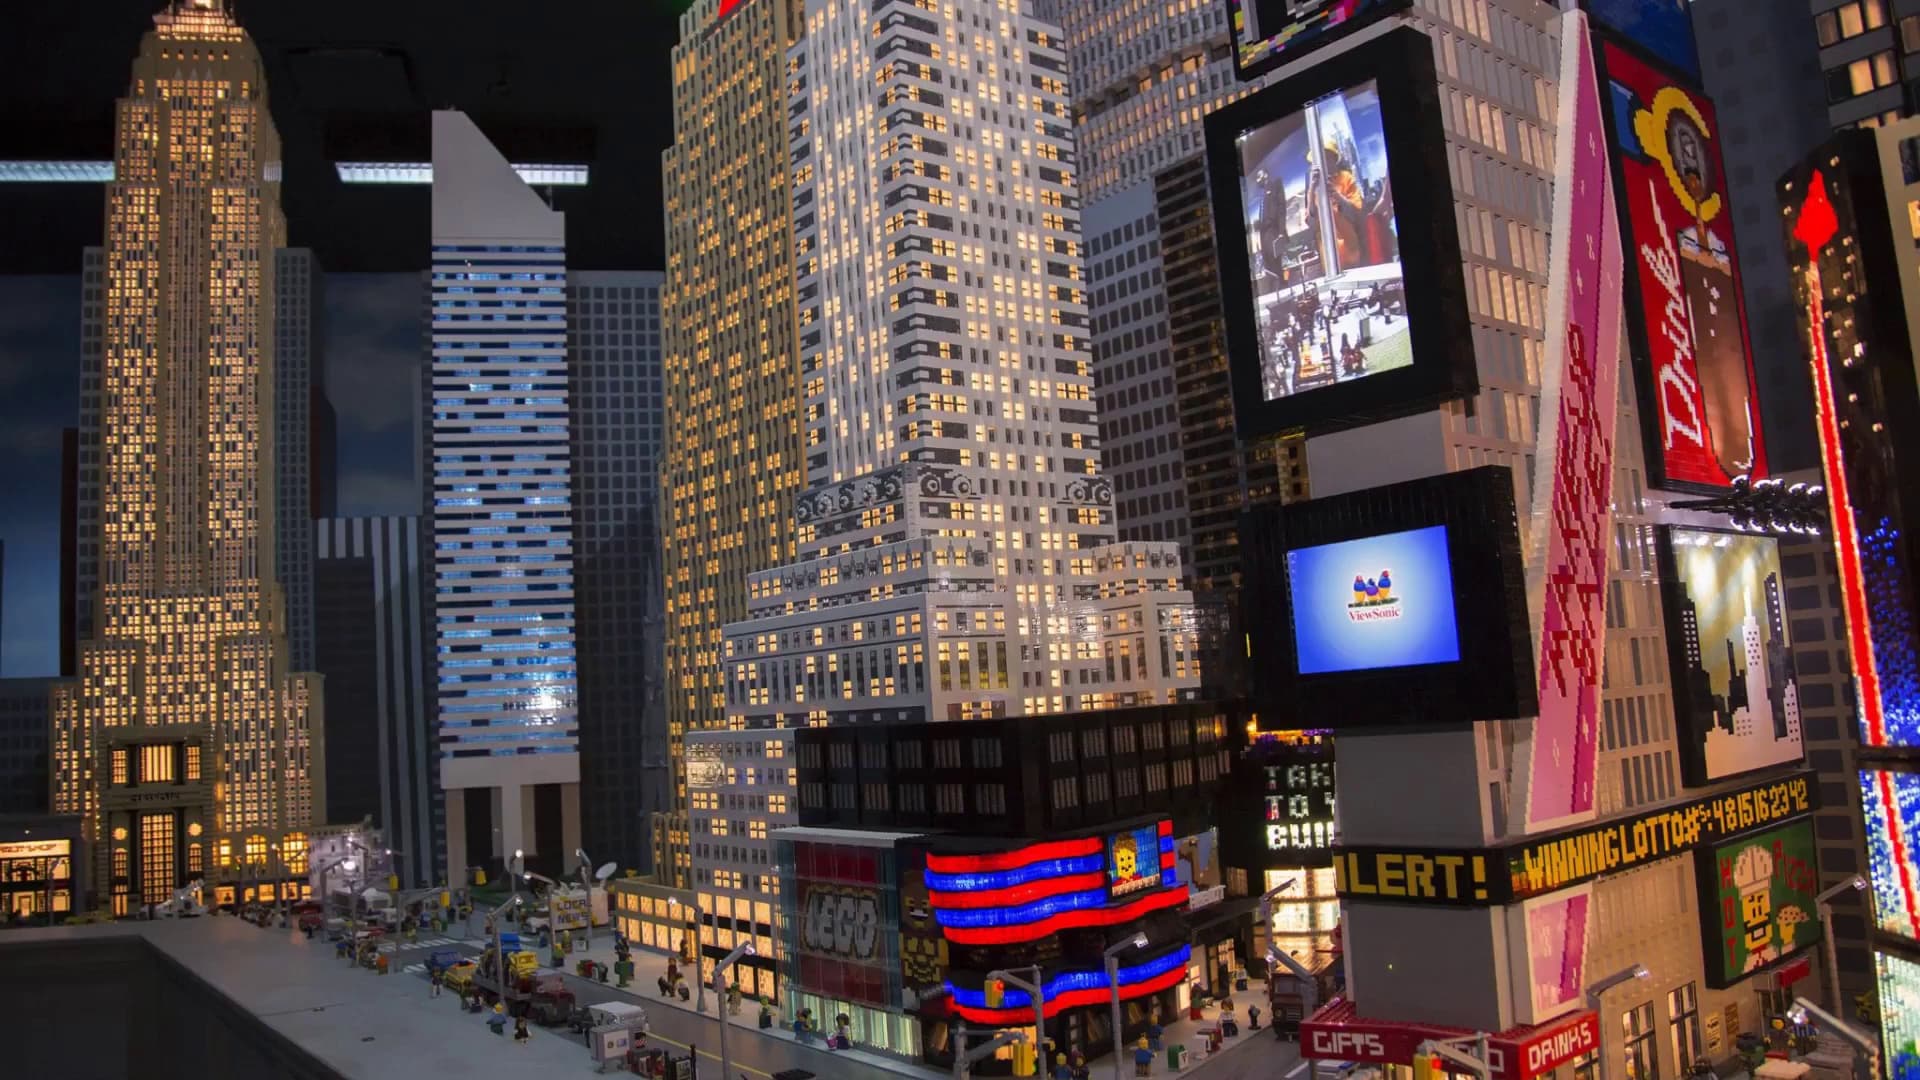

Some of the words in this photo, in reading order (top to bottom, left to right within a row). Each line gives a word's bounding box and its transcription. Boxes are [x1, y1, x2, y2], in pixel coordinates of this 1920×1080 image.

[1641, 178, 1703, 450] Drink
[1348, 606, 1400, 621] ViewSonic
[1264, 763, 1335, 789] TAK
[1265, 794, 1309, 820] TO
[1523, 828, 1620, 891] WINNING
[1620, 811, 1685, 864] LOTTO
[806, 893, 878, 958] LEGO
[1720, 856, 1737, 969] HOT
[1313, 1031, 1384, 1056] GIFTS
[1528, 1022, 1592, 1071] DRINKS
